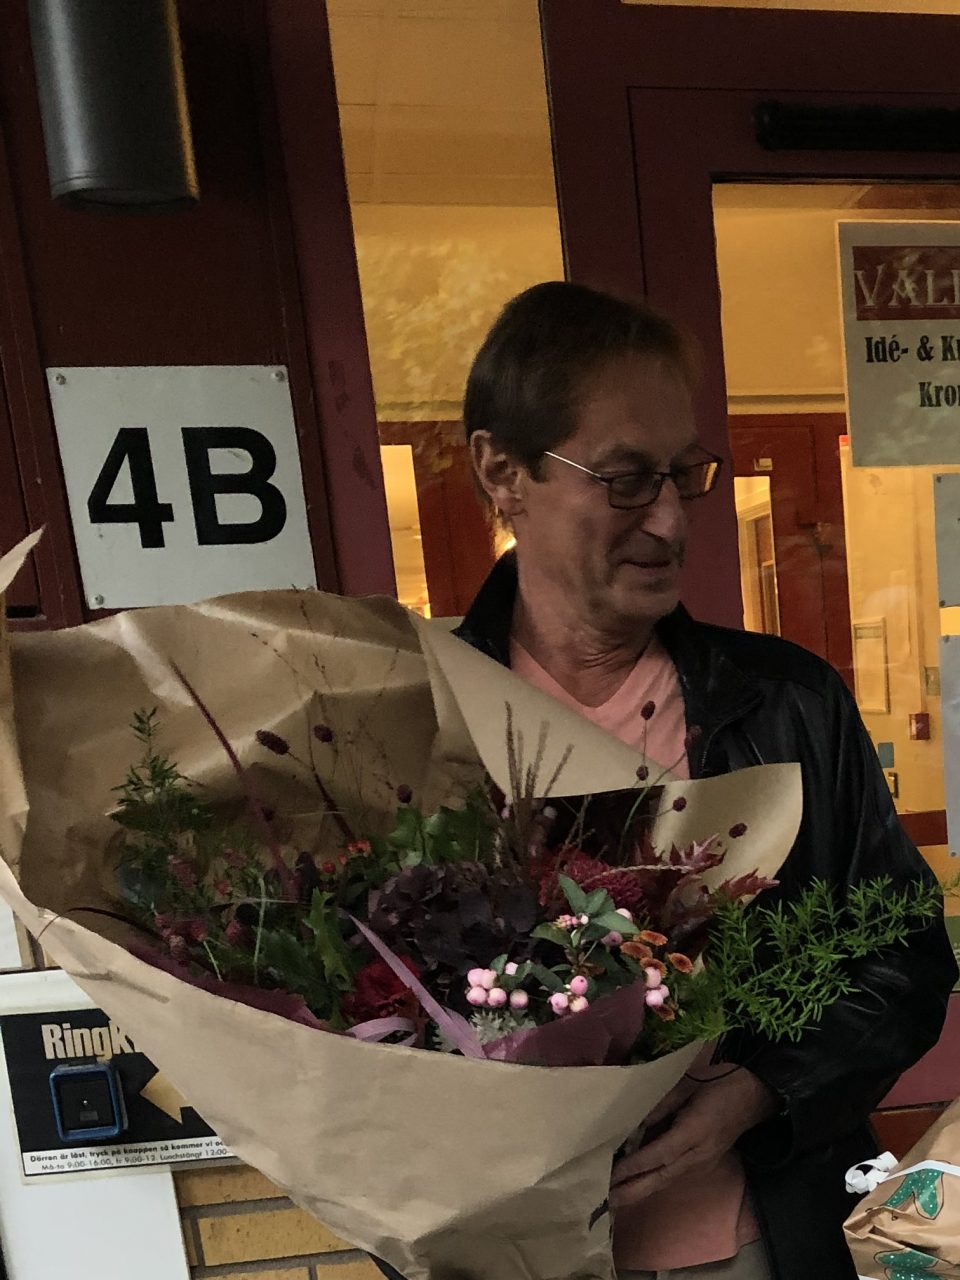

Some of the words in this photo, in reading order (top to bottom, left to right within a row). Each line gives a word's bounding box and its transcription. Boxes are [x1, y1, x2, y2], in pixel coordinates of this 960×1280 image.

[865, 334, 909, 363] Idé-
[916, 335, 935, 362] &
[87, 426, 287, 549] 4B
